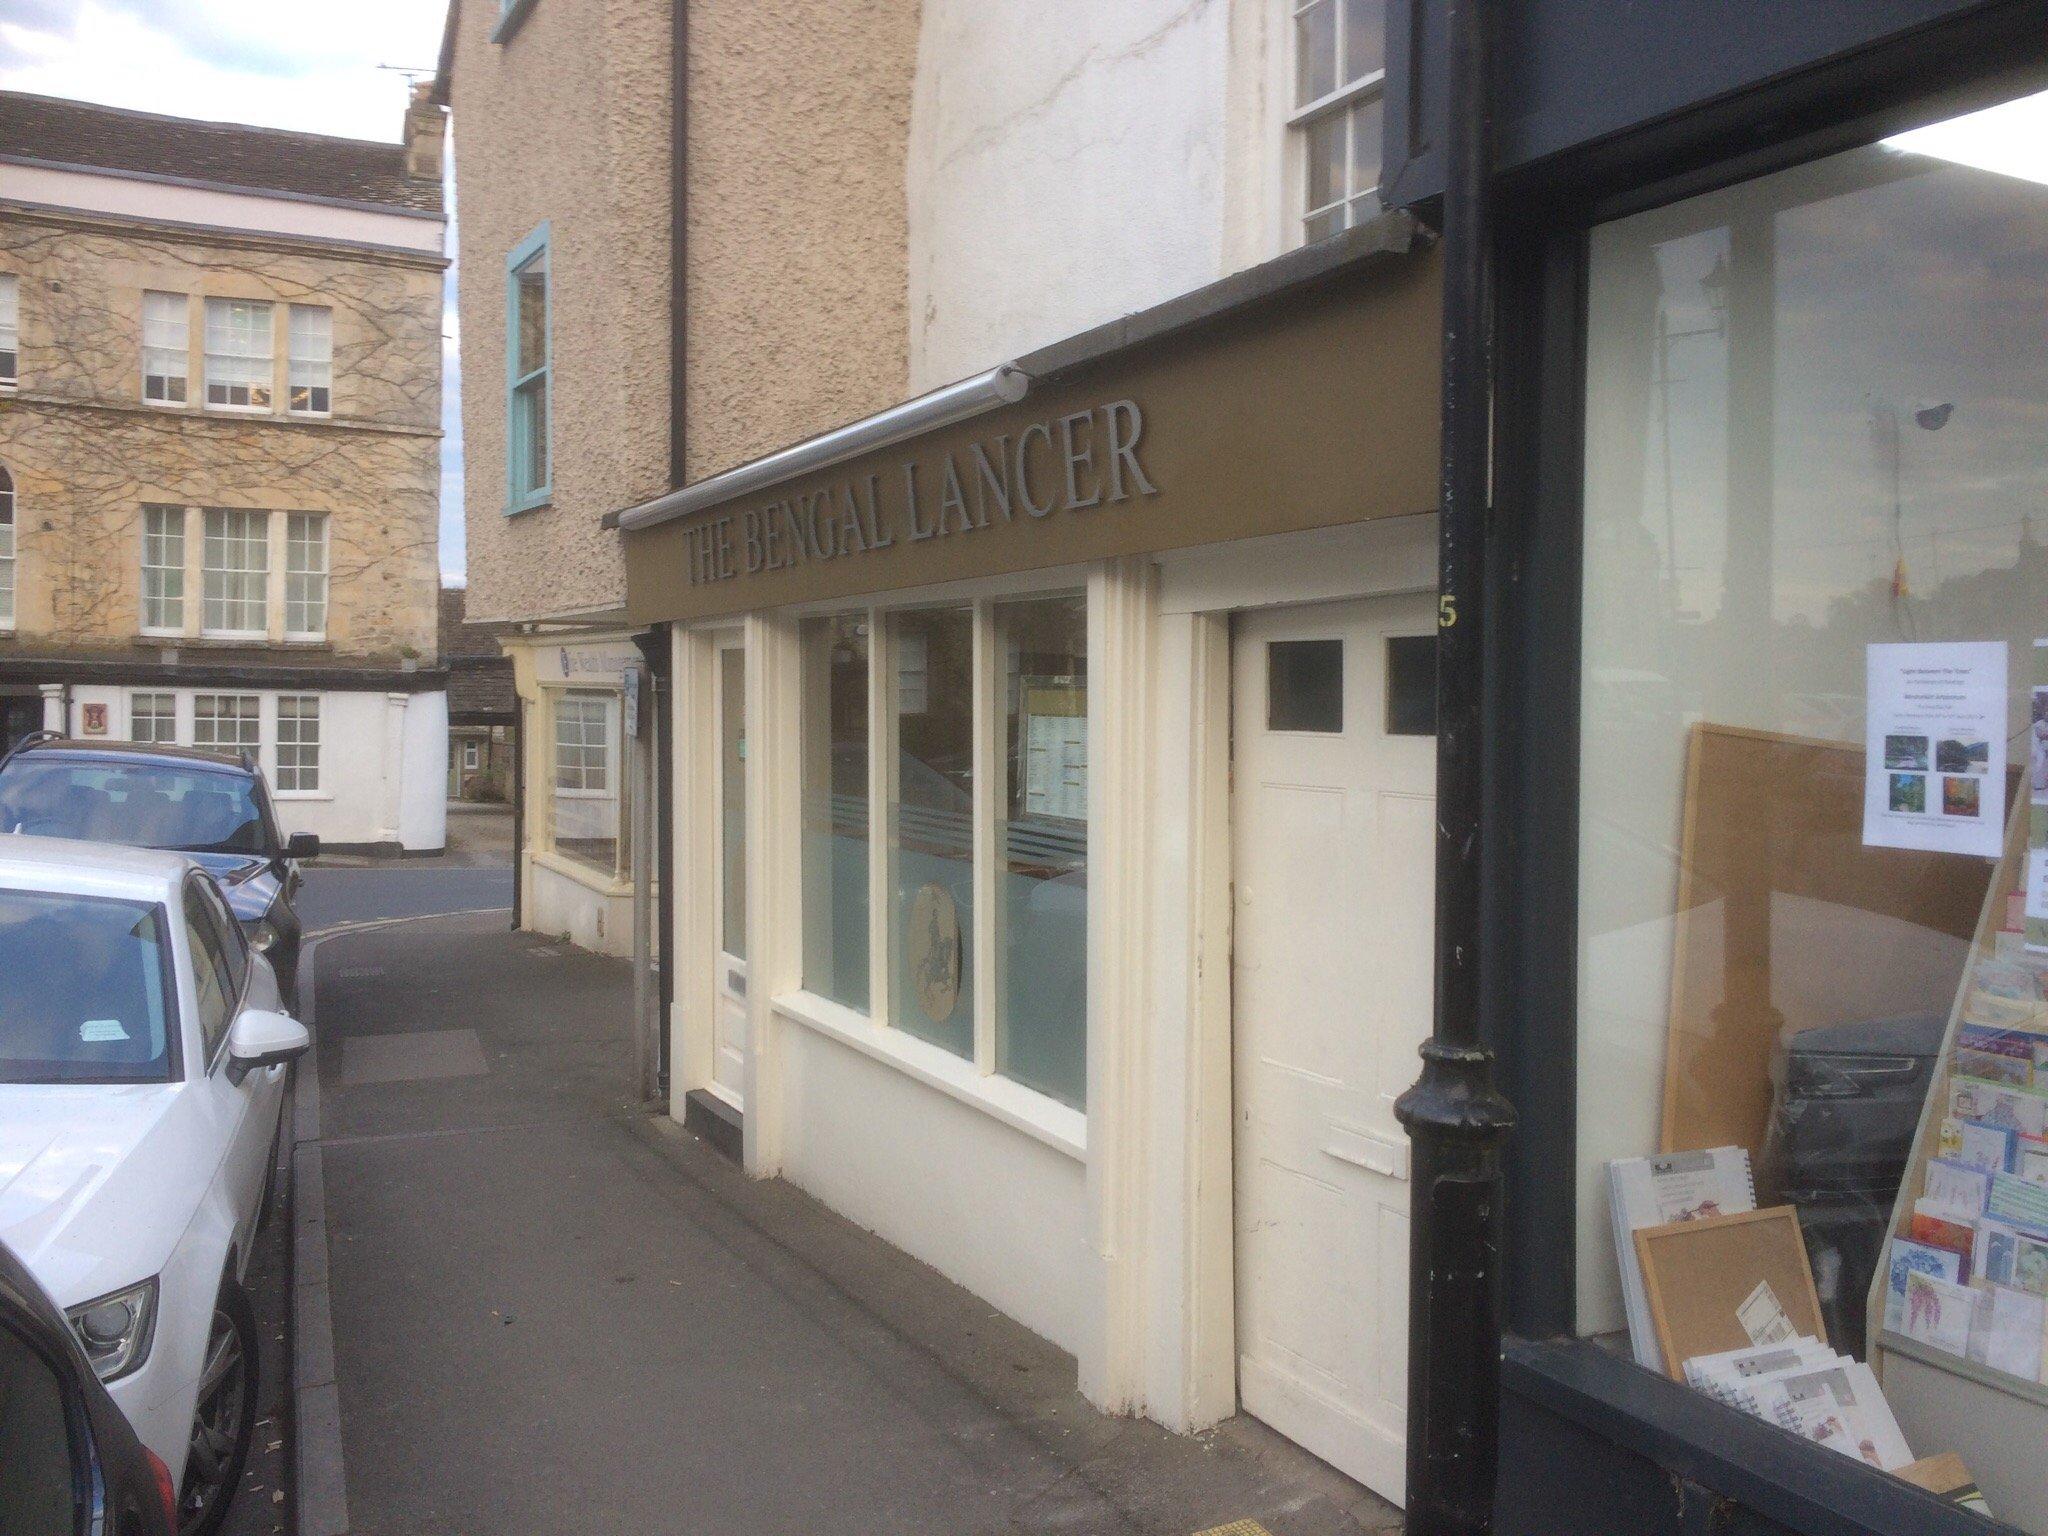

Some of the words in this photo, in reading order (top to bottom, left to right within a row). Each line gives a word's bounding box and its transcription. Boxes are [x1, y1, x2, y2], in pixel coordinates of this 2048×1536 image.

[684, 516, 736, 585] THE
[744, 473, 894, 573] BENGAL
[905, 398, 1158, 543] LANCER
[1439, 594, 1457, 627] 5
